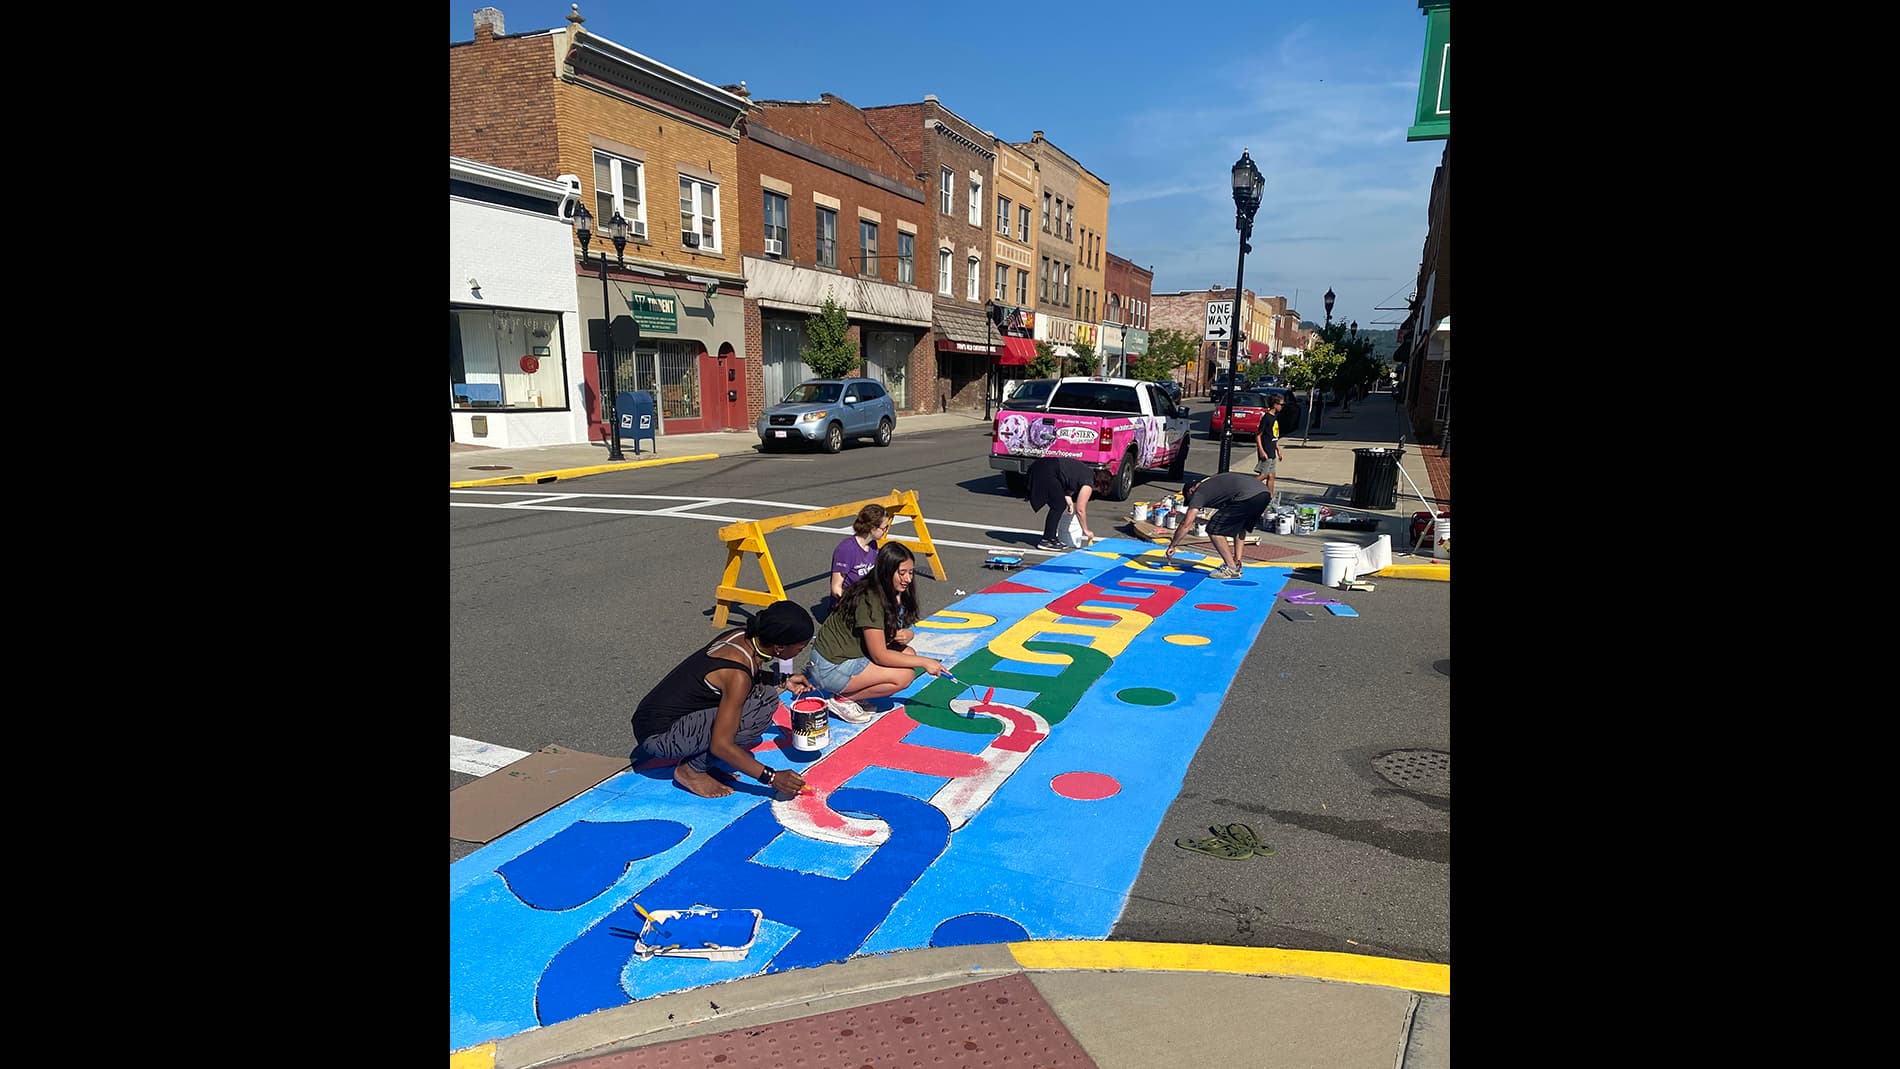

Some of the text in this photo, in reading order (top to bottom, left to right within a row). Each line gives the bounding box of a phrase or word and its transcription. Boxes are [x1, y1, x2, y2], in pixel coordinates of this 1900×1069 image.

[647, 297, 674, 314] TRIDENT
[1209, 304, 1231, 314] ONE
[1208, 315, 1231, 325] WAY
[1048, 320, 1073, 341] JUKE
